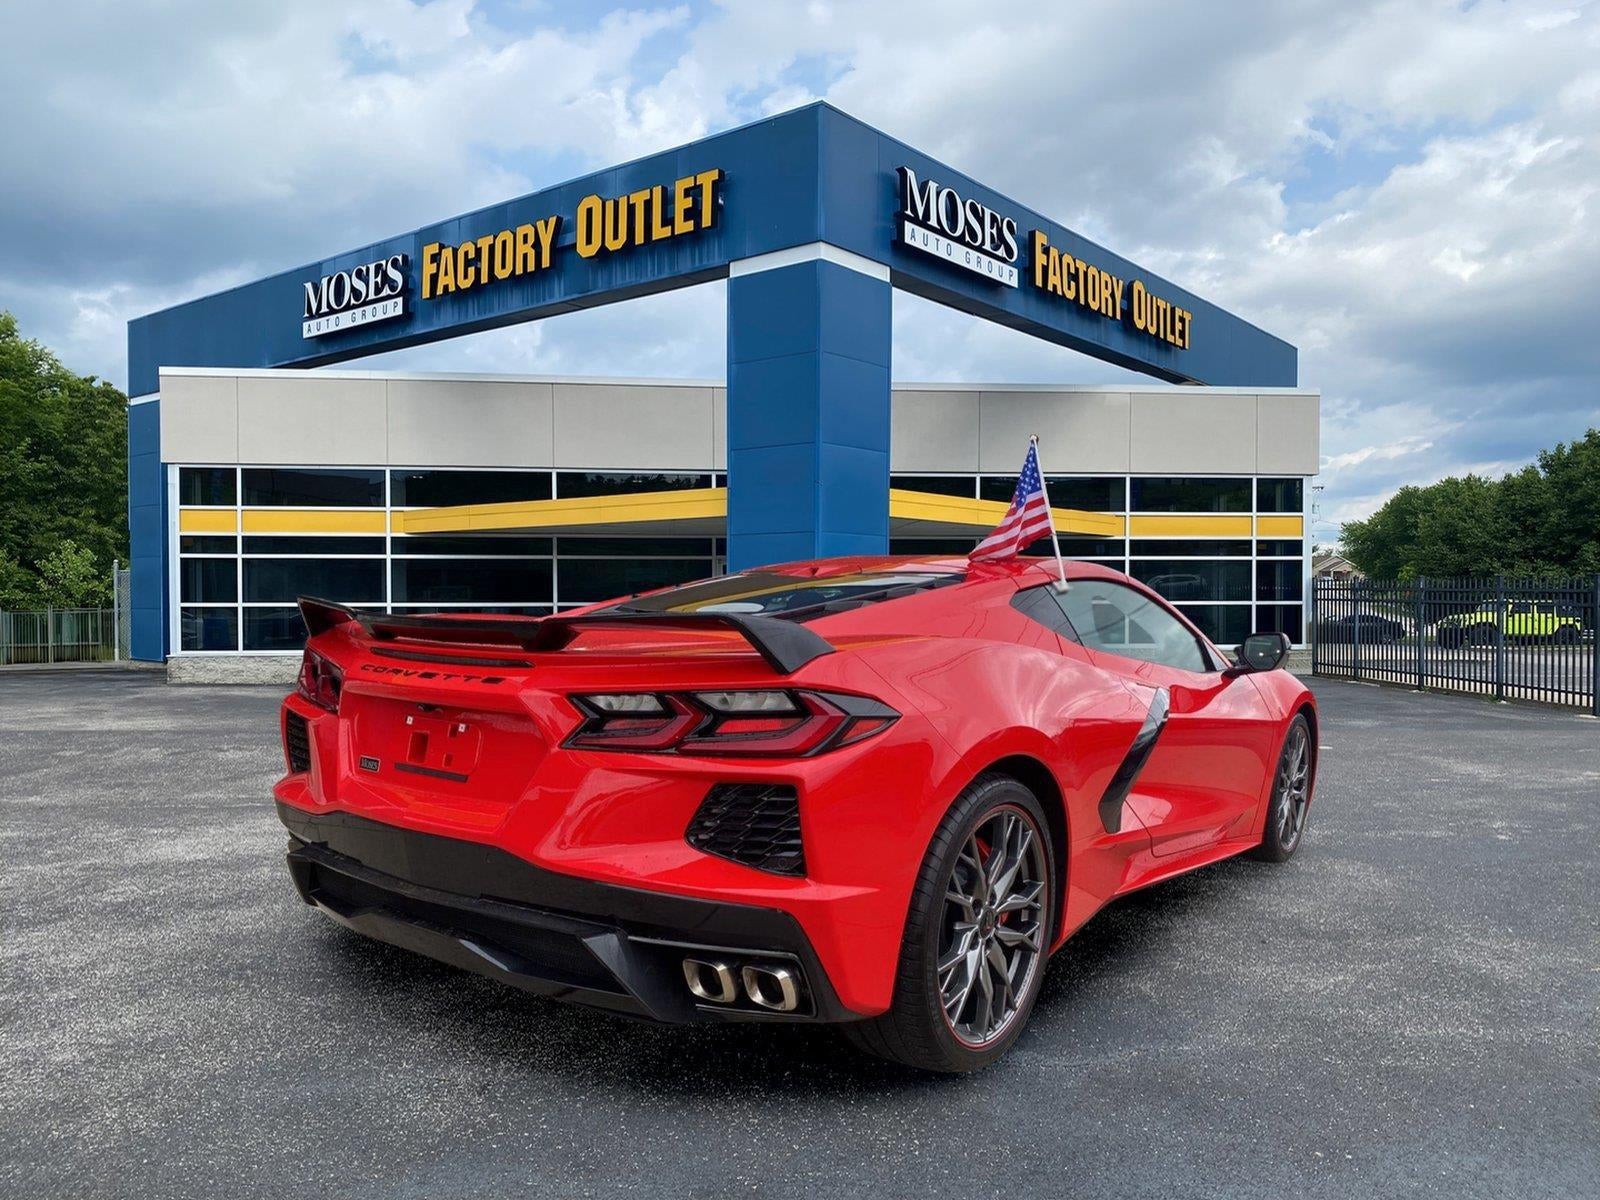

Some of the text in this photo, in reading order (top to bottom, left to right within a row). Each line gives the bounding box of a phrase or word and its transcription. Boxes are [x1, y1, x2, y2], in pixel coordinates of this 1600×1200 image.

[422, 169, 720, 298] FACTORY OUTLET
[904, 167, 1018, 262] MOSES
[303, 254, 403, 318] MOSES
[910, 228, 1015, 281] AUTO GROUP
[307, 301, 399, 334] AUTO GROUP
[1035, 230, 1193, 349] FACTORY OUTLET
[361, 665, 505, 684] CORVETTE
